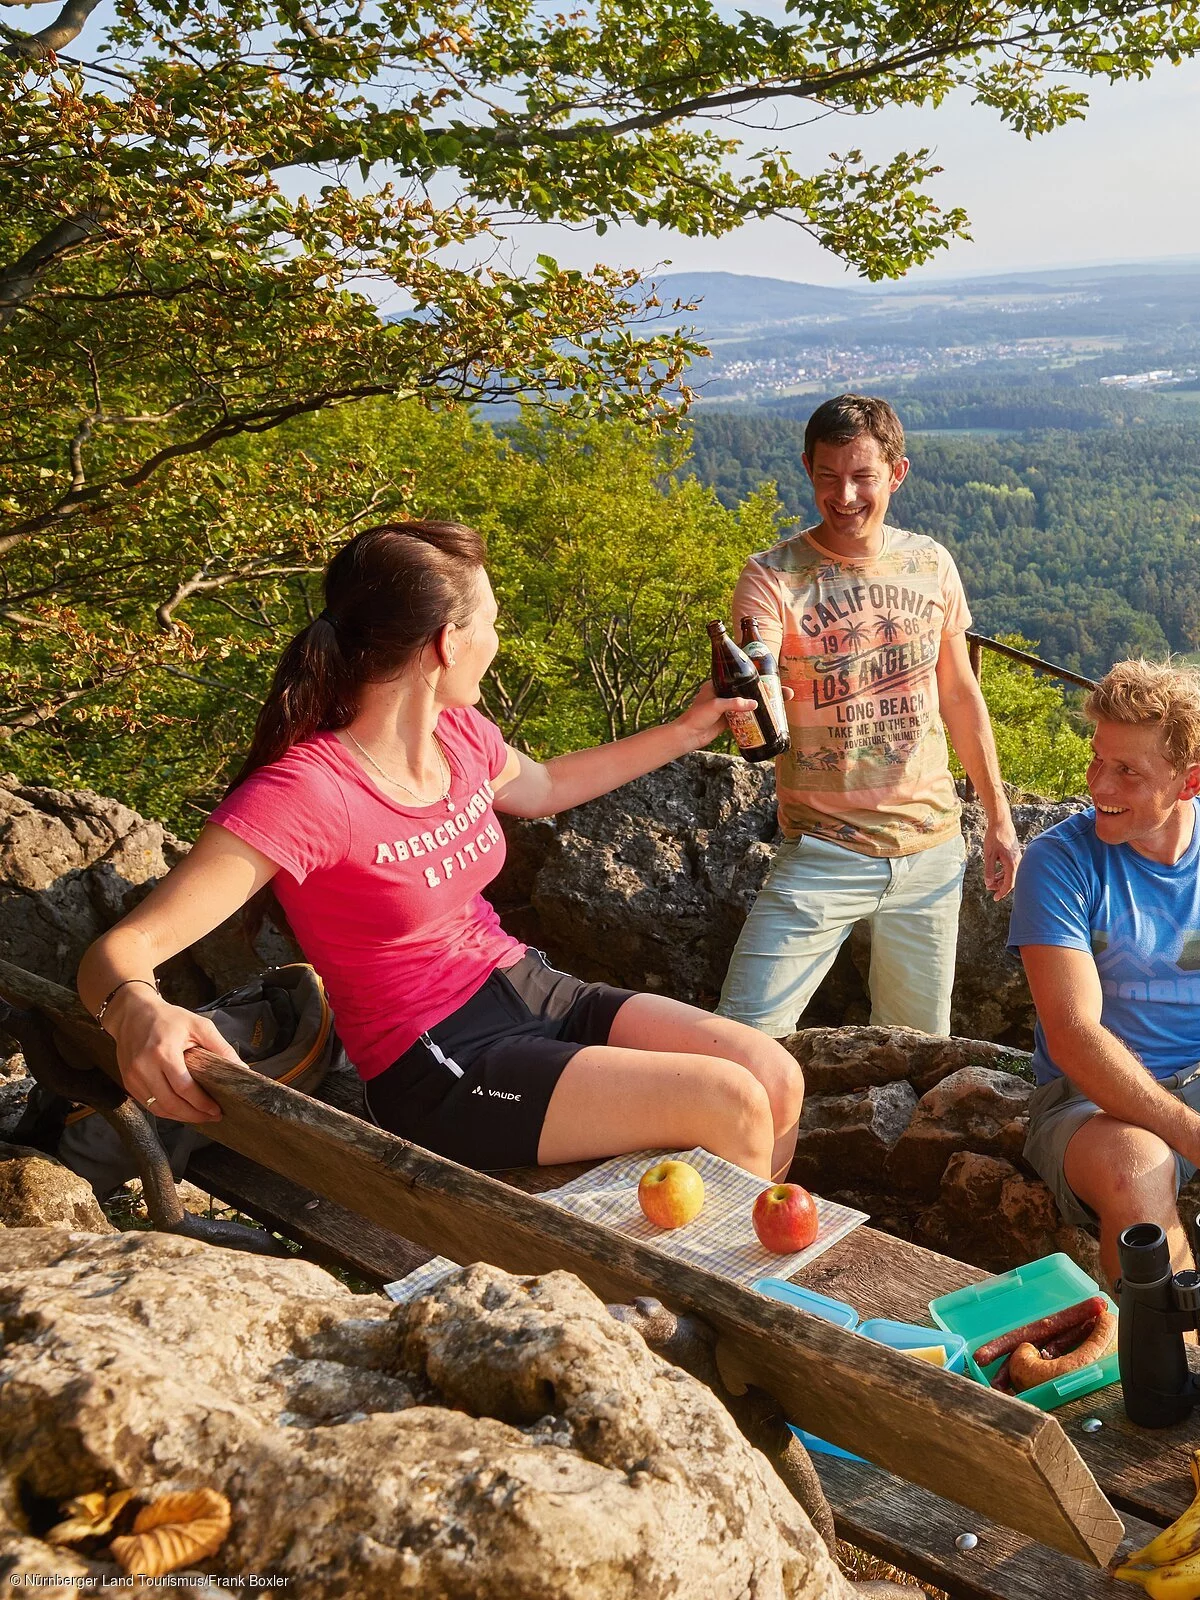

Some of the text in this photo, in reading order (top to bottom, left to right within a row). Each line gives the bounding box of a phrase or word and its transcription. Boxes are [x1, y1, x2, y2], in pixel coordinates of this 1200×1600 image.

[800, 584, 935, 638] CALIFORNIA
[820, 616, 920, 655] 19 86
[813, 629, 937, 710] LOS ANGELES
[836, 693, 924, 723] LONG BEACH
[827, 726, 853, 738] TAKE
[856, 723, 870, 736] ME
[873, 720, 885, 733] TO
[887, 718, 906, 731] THE
[844, 735, 886, 750] ADVENTURE
[424, 823, 500, 888] & FITCH
[488, 1089, 522, 1102] VAUDE
